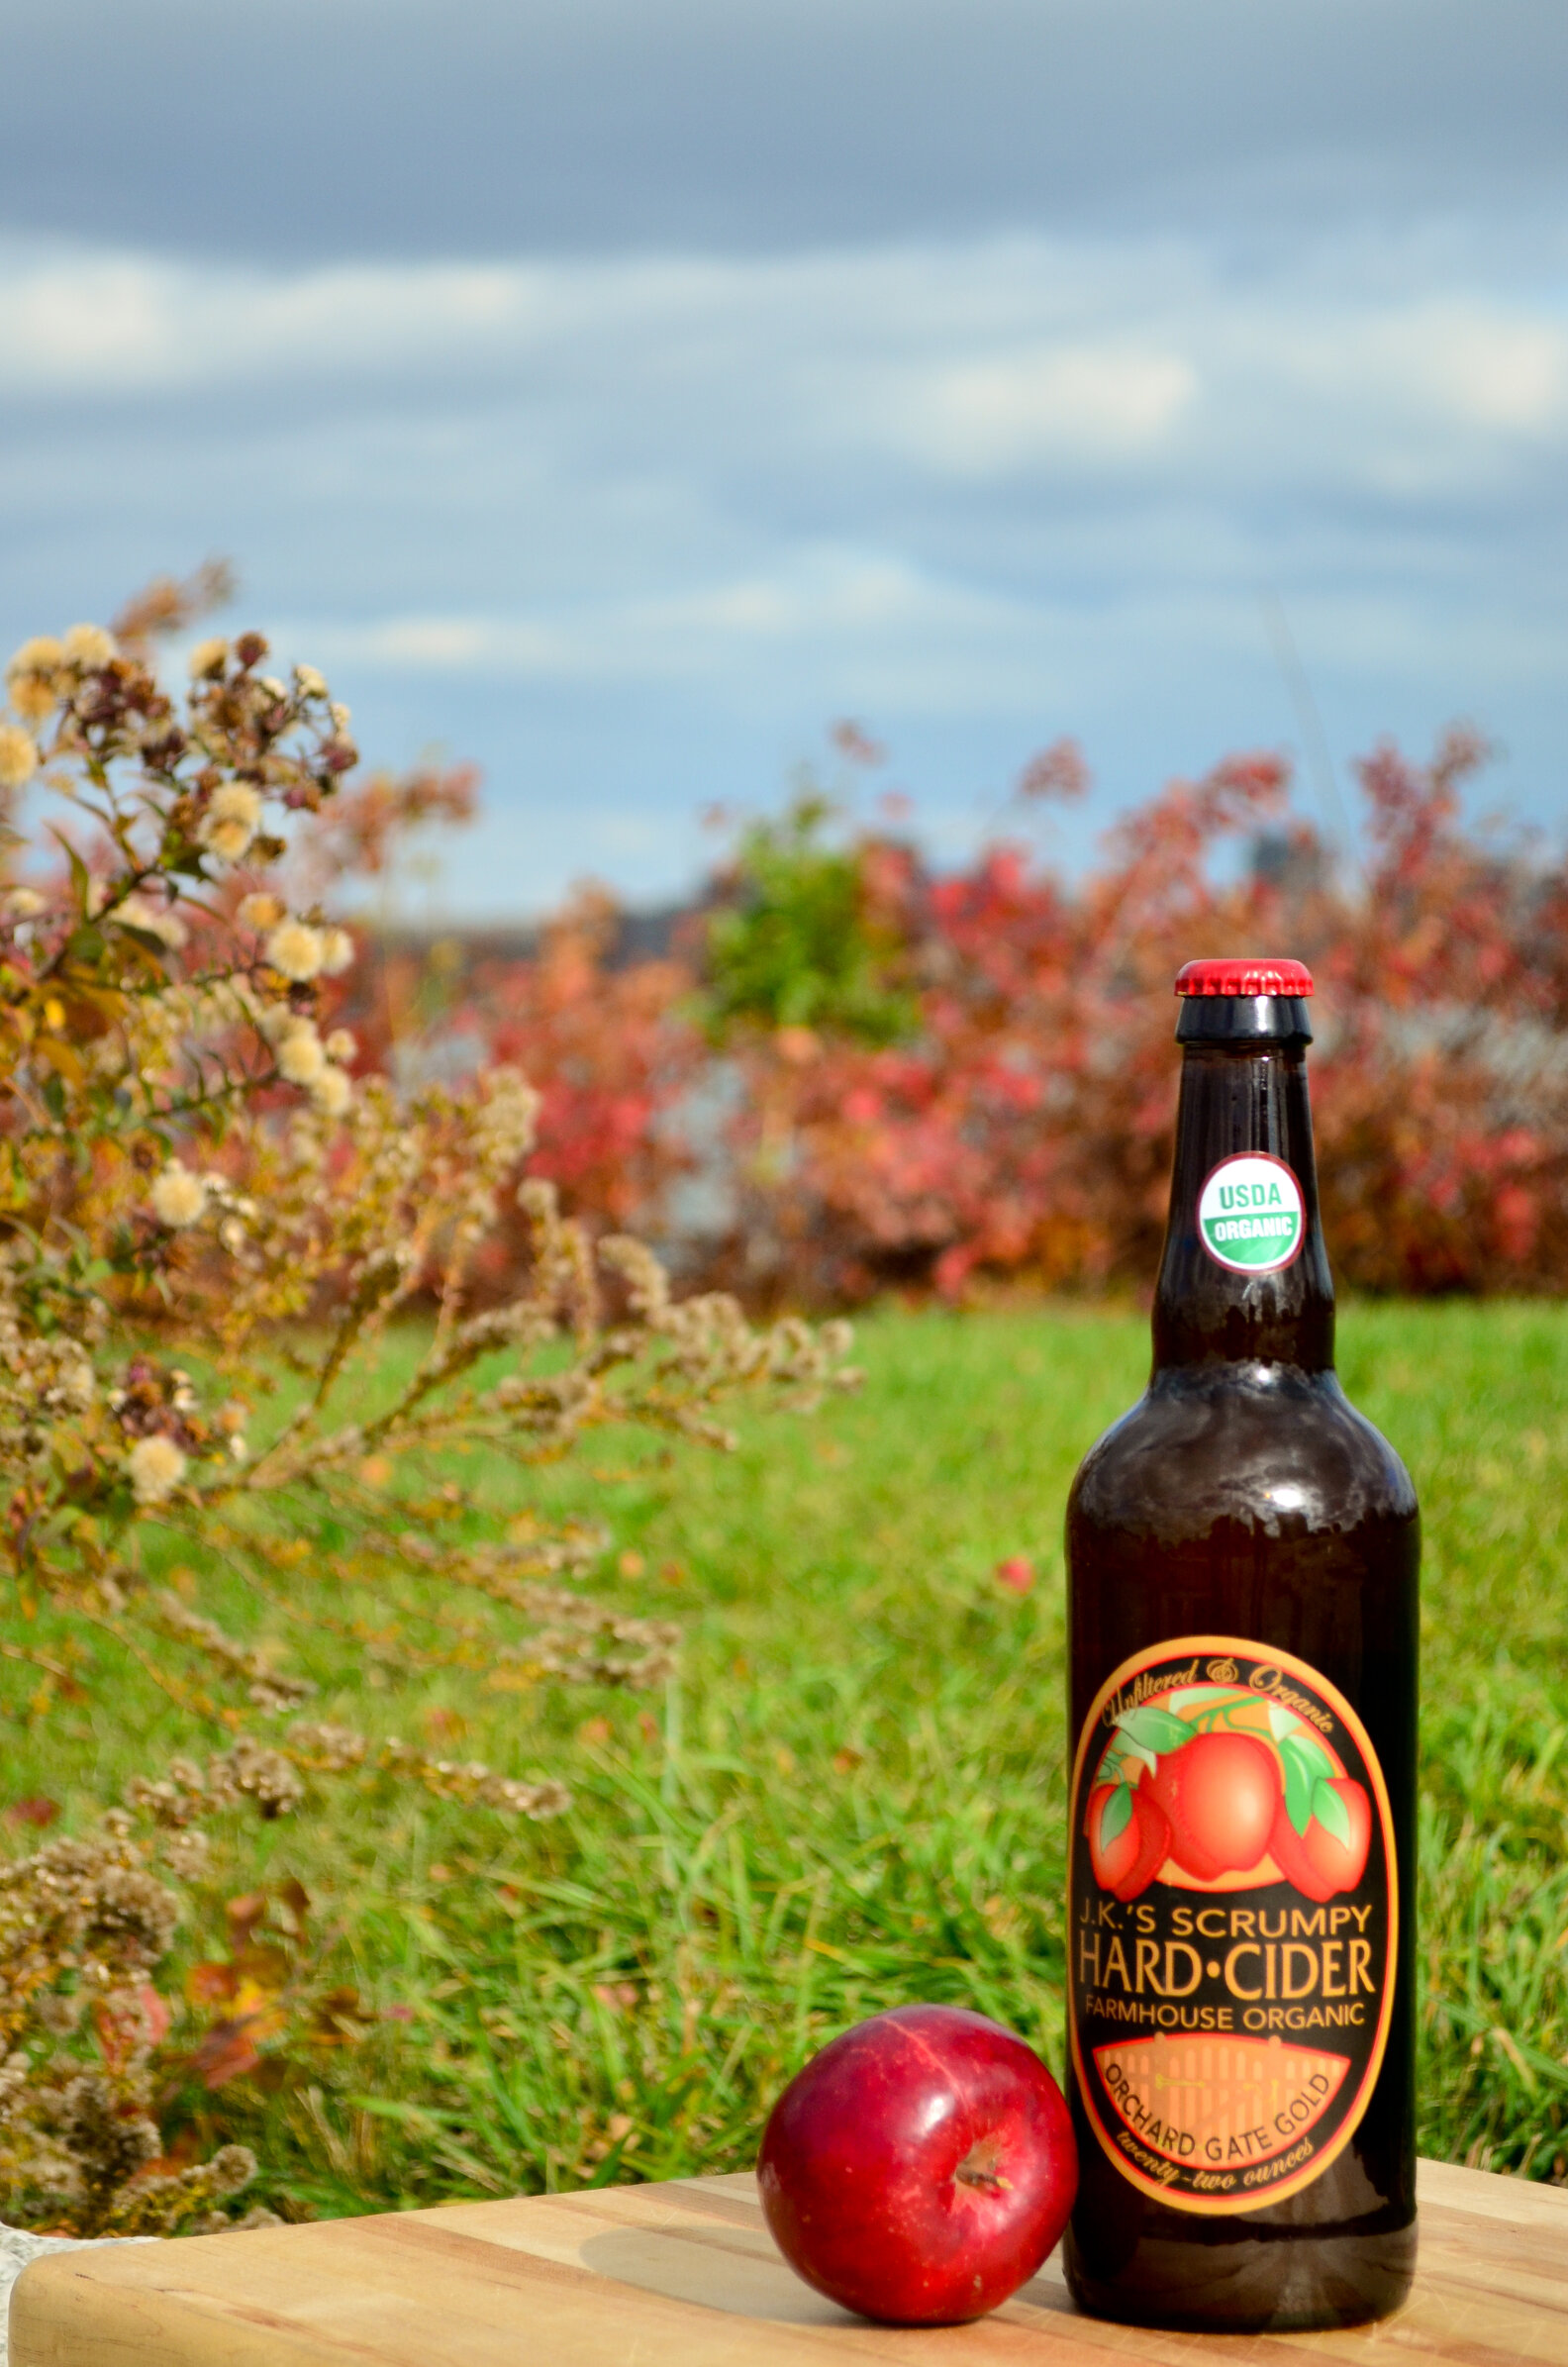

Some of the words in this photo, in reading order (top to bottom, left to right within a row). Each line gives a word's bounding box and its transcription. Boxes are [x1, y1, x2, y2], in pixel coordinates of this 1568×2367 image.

[1219, 1182, 1282, 1210] USDA
[1214, 1216, 1293, 1242] ORGANIC
[1101, 1657, 1201, 1728] Unfiltered
[1206, 1657, 1239, 1683] &
[1249, 1664, 1334, 1732] Organic
[1080, 1897, 1157, 1933] J.K.'S
[1171, 1904, 1373, 1939] SCRUMPY
[1085, 1994, 1234, 2030] FARMHOUSE
[1242, 2002, 1365, 2030] ORGANIC
[1105, 2062, 1196, 2157] ORCHARD
[1205, 2125, 1273, 2161] GATE
[1273, 2072, 1330, 2136] GOLD
[1116, 2129, 1237, 2190] twenty-two
[1242, 2136, 1315, 2188] ounces
